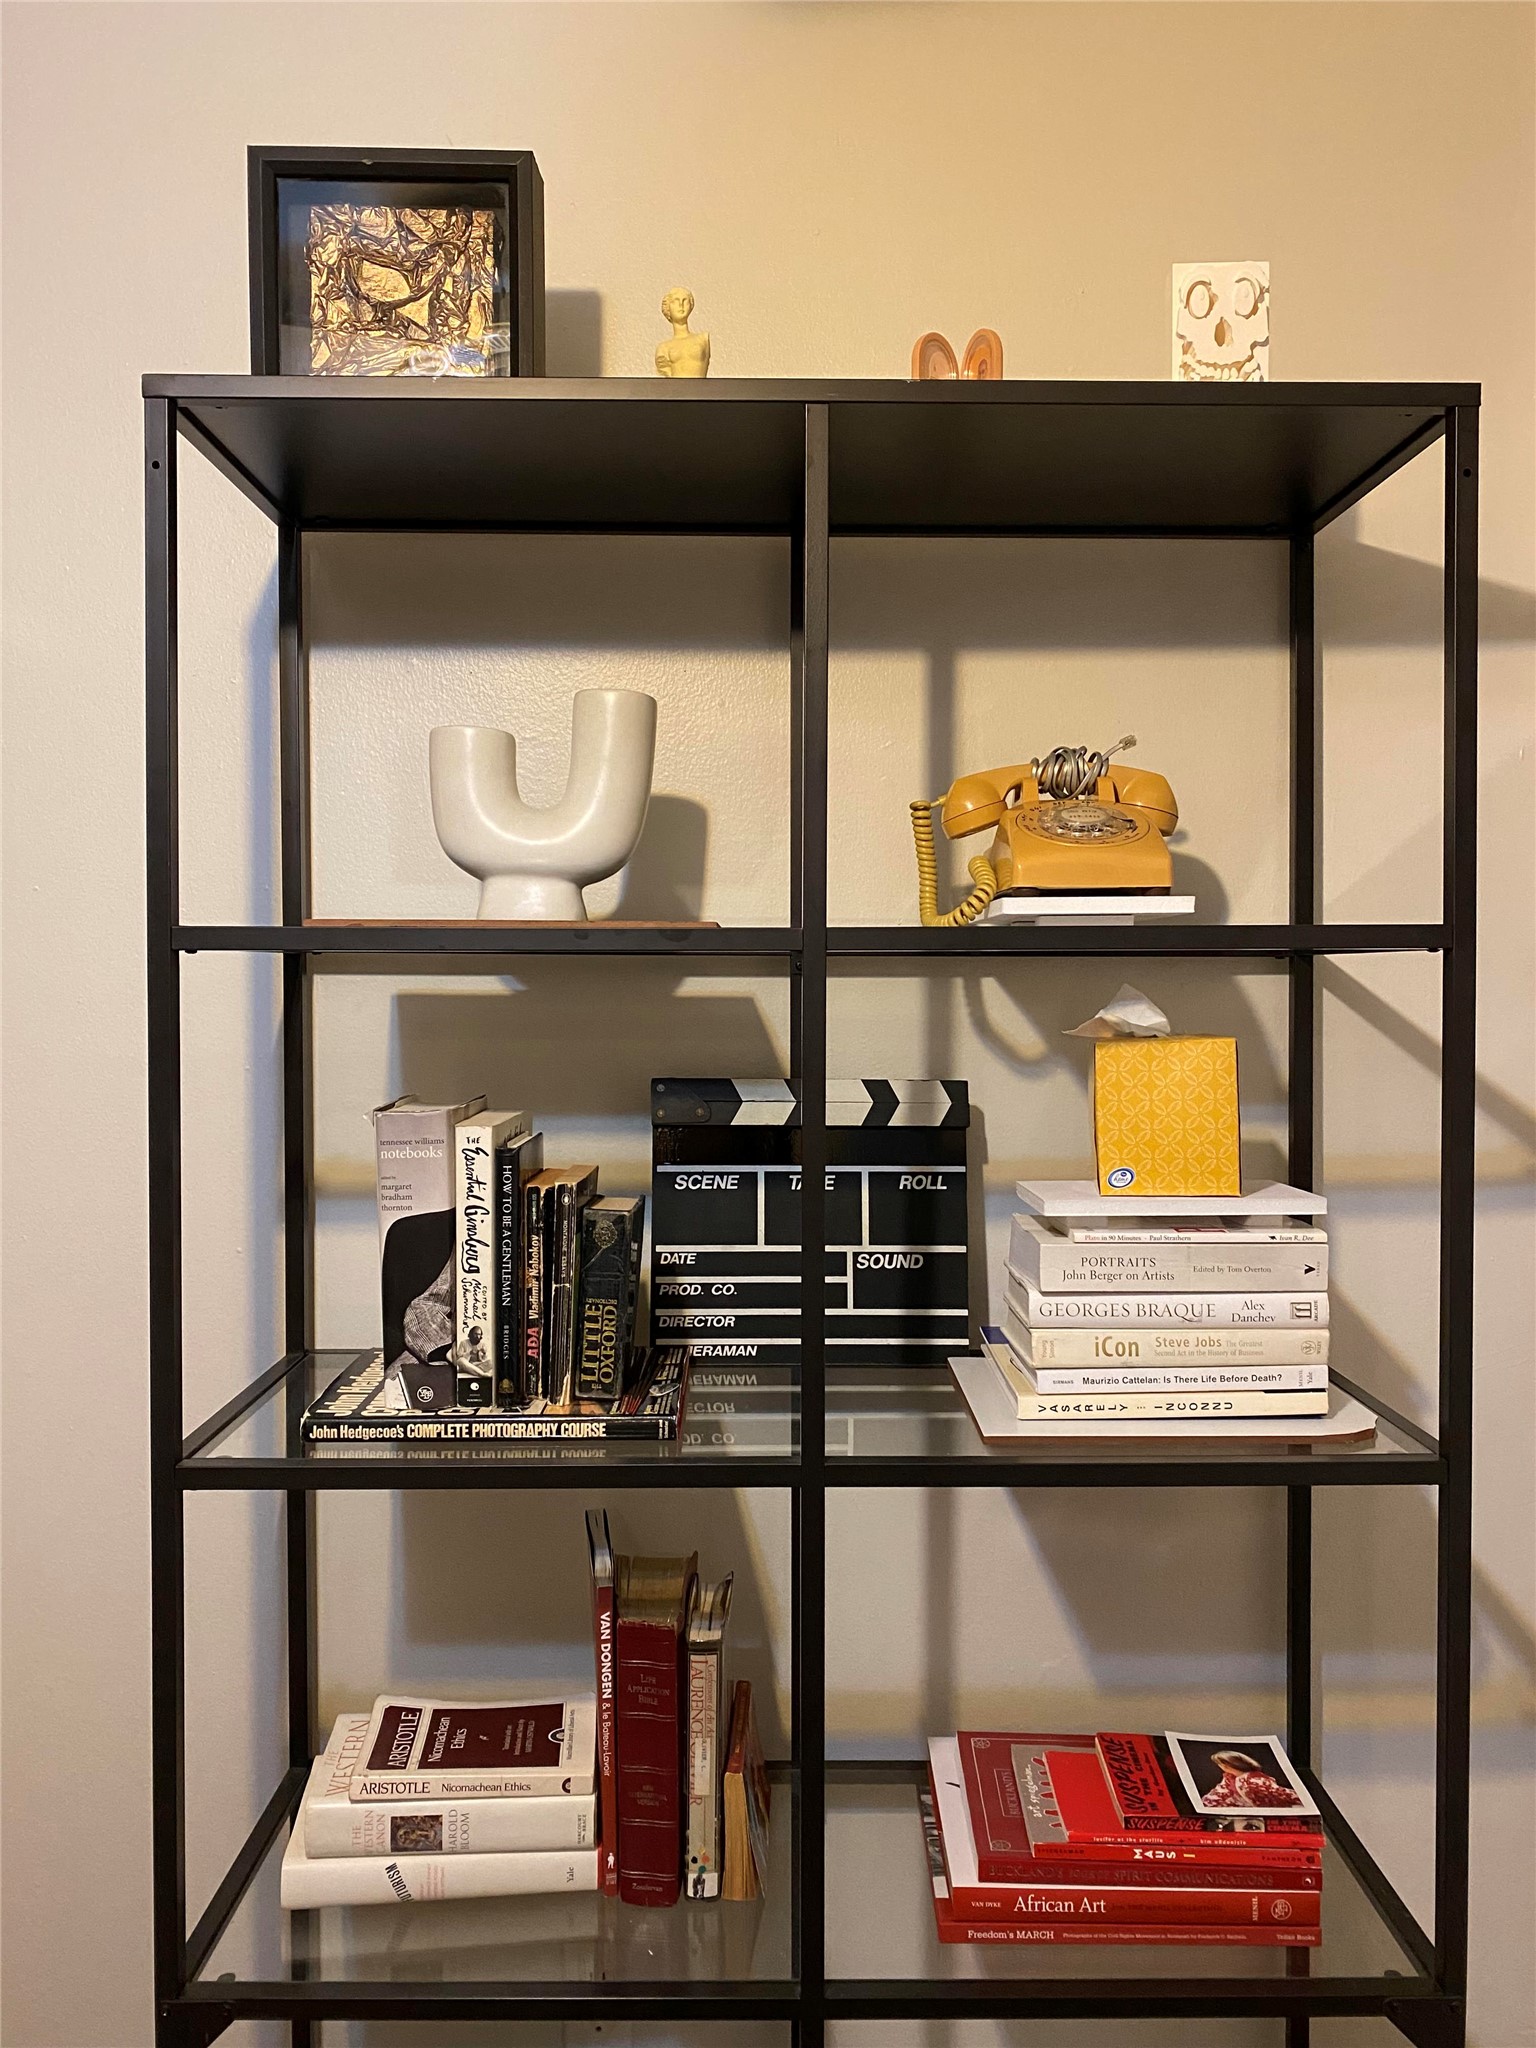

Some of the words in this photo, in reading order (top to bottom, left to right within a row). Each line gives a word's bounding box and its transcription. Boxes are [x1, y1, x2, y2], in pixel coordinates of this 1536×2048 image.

[414, 1137, 445, 1145] williams
[466, 1136, 481, 1144] THE
[380, 1146, 443, 1159] notebooks
[502, 1165, 512, 1194] HOW
[674, 1175, 739, 1190] SCENE
[789, 1175, 836, 1190] TE
[899, 1175, 947, 1190] ROLL
[381, 1183, 412, 1192] margaret
[381, 1193, 413, 1201] bradham
[381, 1203, 413, 1211] thornton
[502, 1196, 512, 1216] TO
[502, 1217, 512, 1227] BE
[502, 1229, 512, 1237] A
[529, 1235, 540, 1277] Nabokov
[660, 1253, 697, 1265] DATE
[856, 1254, 924, 1270] SOUND
[1081, 1257, 1157, 1267] PORTRAITS
[502, 1239, 512, 1306] GENTLEMAN
[1063, 1270, 1086, 1281] John
[1090, 1270, 1123, 1283] Berger
[1142, 1270, 1175, 1281] Artists
[1217, 1266, 1225, 1274] by
[659, 1284, 704, 1296] PROD.
[711, 1284, 737, 1296] CO.
[529, 1279, 540, 1319] Vladimir
[1242, 1300, 1265, 1311] Alex
[1039, 1302, 1130, 1317] GEORGES
[1137, 1302, 1216, 1322] BRAQUE
[1231, 1312, 1276, 1323] Danchev
[659, 1316, 735, 1328] DIRECTOR
[527, 1327, 540, 1359] ADA
[581, 1304, 603, 1382] LITTLE
[600, 1305, 617, 1384] OXFORD
[1095, 1336, 1140, 1357] iCon
[1155, 1336, 1190, 1348] Steve
[1195, 1336, 1222, 1348] Jobs
[690, 1345, 757, 1357] ERAMAN
[1208, 1349, 1229, 1357] History
[1082, 1376, 1120, 1385] Maurizio
[1121, 1376, 1161, 1384] Cattelan:
[1163, 1376, 1171, 1384] Is
[1174, 1375, 1198, 1384] There
[1201, 1375, 1217, 1383] Life
[1219, 1374, 1249, 1383] Before
[1251, 1374, 1283, 1382] Death?
[1038, 1404, 1128, 1413] VASARELY
[1154, 1402, 1233, 1411] INCONNU
[310, 1425, 338, 1439] John
[340, 1425, 404, 1440] Hedgecoe's
[407, 1423, 469, 1438] COMPLETE
[472, 1423, 558, 1438] PHOTOGRAPHY
[561, 1422, 607, 1437] COURSE
[600, 1612, 611, 1640] VAN
[600, 1643, 613, 1699] DONGEN
[627, 1684, 670, 1696] APPLICATION
[706, 1664, 715, 1703] Confessions
[638, 1694, 658, 1705] BIBLE
[690, 1660, 709, 1739] LAURENCE
[602, 1711, 612, 1720] le
[706, 1713, 715, 1724] An
[387, 1712, 420, 1767] ARISTOTLE
[428, 1717, 450, 1762] Nicomachean
[451, 1728, 467, 1749] Ethics
[602, 1722, 612, 1777] Bateau-Lavoir
[1125, 1740, 1143, 1772] CINEMA
[325, 1720, 370, 1797] WESTERN
[1100, 1734, 1148, 1813] SUSPENSE
[360, 1782, 431, 1794] ARISTOTLE
[441, 1783, 502, 1792] Nicomachean
[504, 1782, 532, 1791] Ethics
[1139, 1778, 1152, 1796] THE
[1028, 1806, 1042, 1818] art
[448, 1809, 458, 1852] HAROLD
[460, 1812, 470, 1850] BLOOM
[1127, 1818, 1204, 1830] SUSPENSE
[352, 1825, 361, 1846] THE
[1133, 1848, 1177, 1859] MAUS
[566, 1866, 574, 1883] Yale
[1114, 1870, 1153, 1882] SPIRIT
[1155, 1871, 1273, 1886] COMMUNICATIONS
[632, 1883, 663, 1892] Zondervan
[1013, 1894, 1075, 1912] African
[1079, 1896, 1107, 1913] Art
[1251, 1895, 1259, 1921] MENIL
[967, 1930, 1014, 1939] Freedom's
[1016, 1931, 1054, 1939] MARCH
